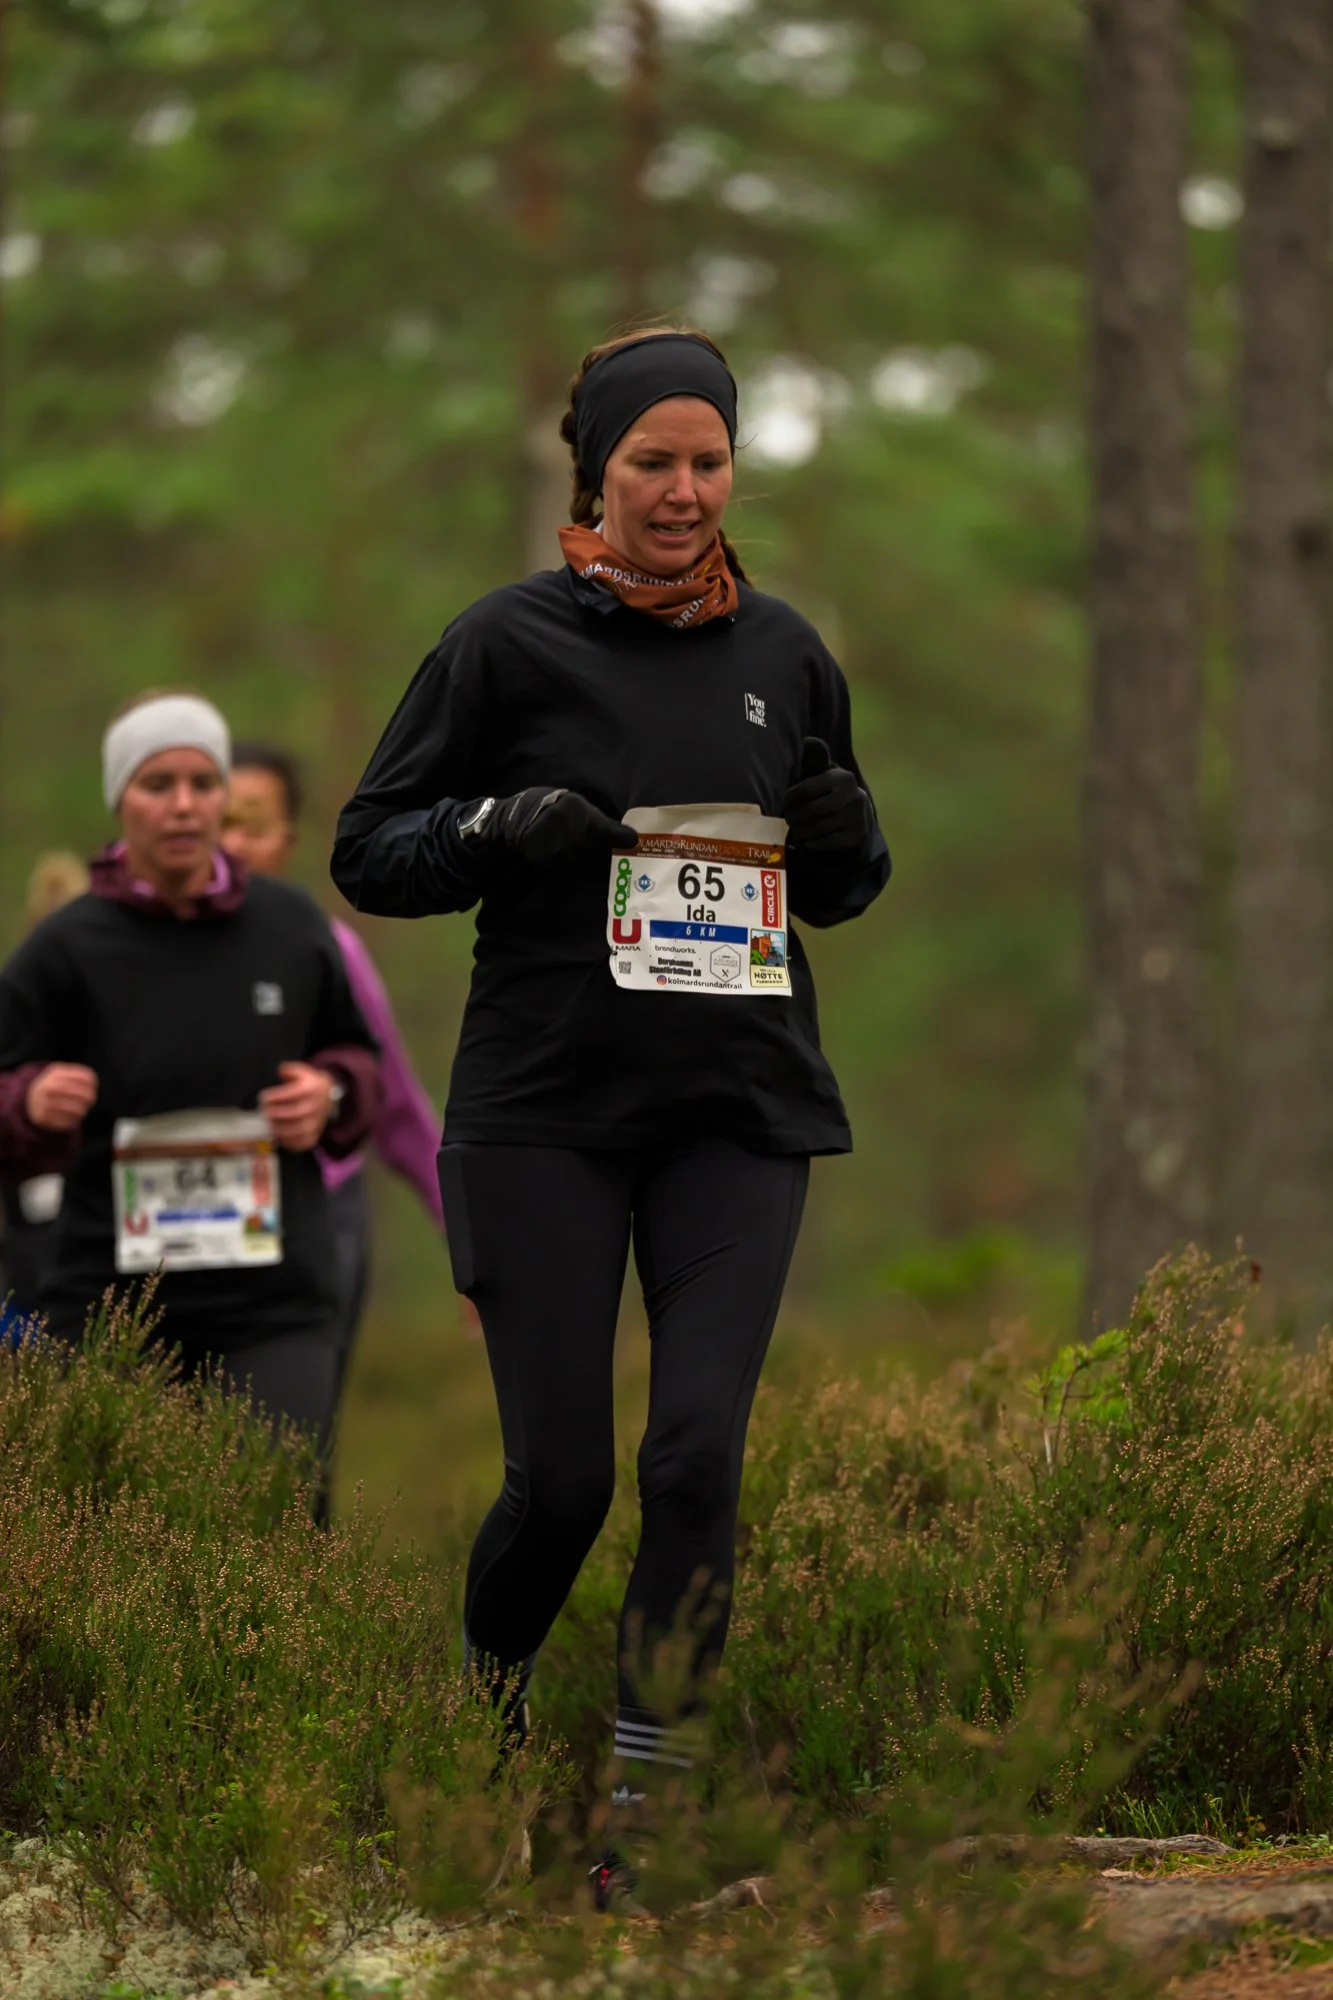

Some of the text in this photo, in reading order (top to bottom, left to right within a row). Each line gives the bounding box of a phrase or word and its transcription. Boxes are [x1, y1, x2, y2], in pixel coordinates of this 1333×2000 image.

[747, 693, 765, 709] You
[677, 863, 725, 902] 65
[686, 904, 716, 923] Ida
[767, 889, 775, 924] CIRCLE
[686, 925, 692, 936] 6
